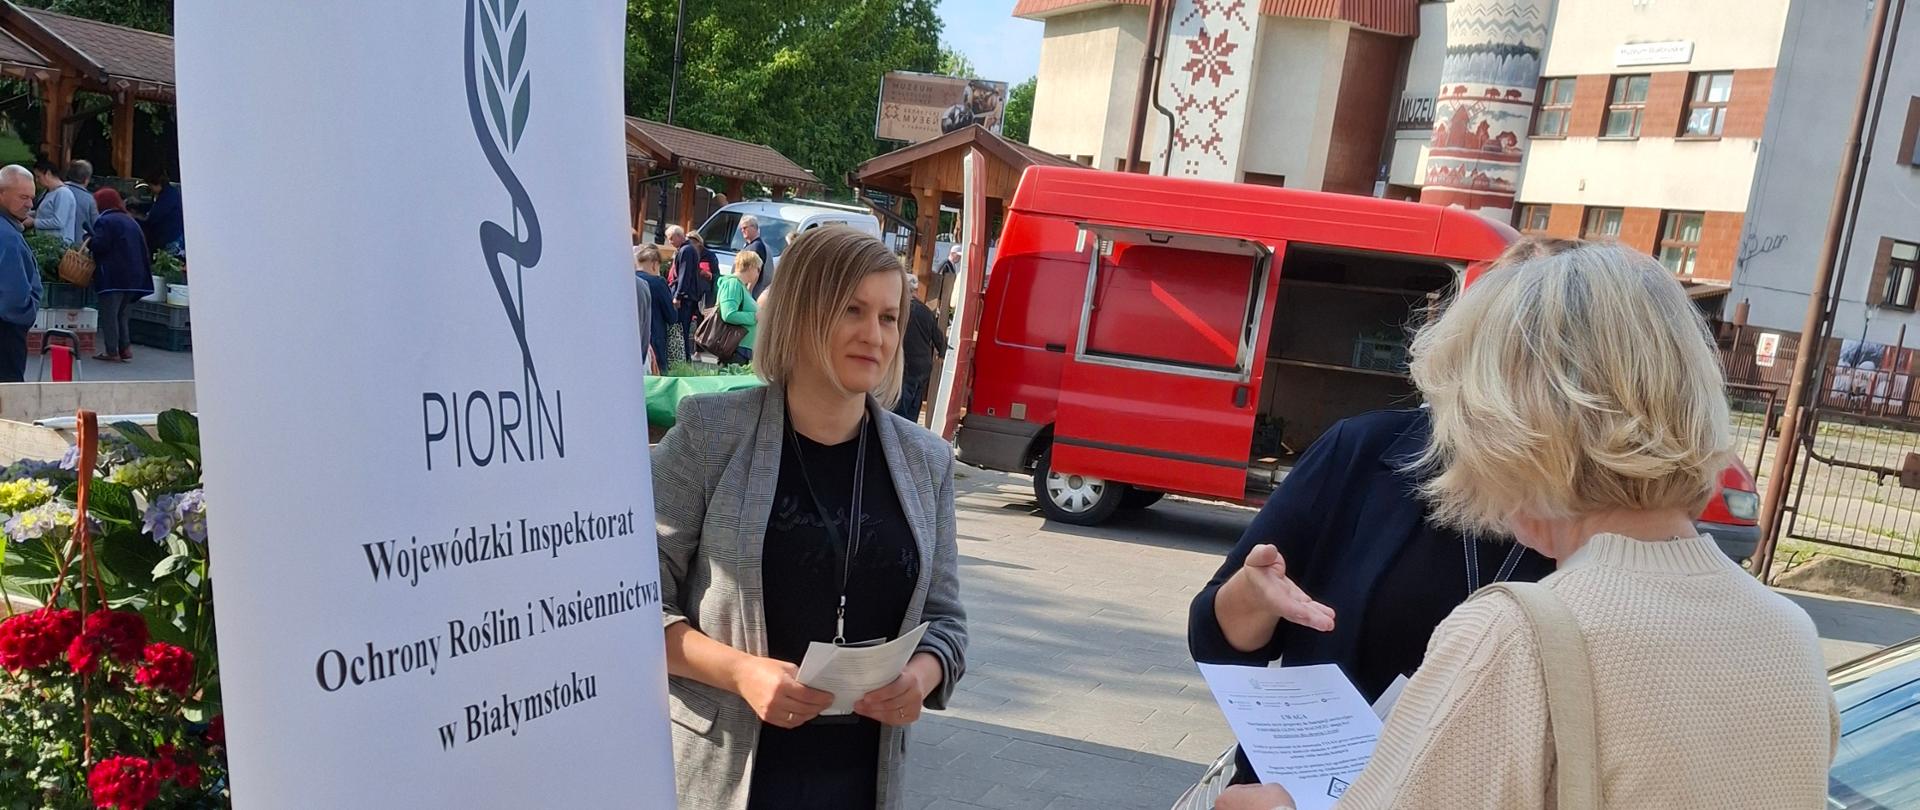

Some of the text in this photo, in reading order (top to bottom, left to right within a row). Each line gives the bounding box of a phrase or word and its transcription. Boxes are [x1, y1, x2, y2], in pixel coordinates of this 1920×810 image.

[1400, 97, 1437, 121] MUZEU
[422, 389, 566, 471] PIORIN
[362, 506, 635, 587] Wojewódzki Inspektorat
[315, 579, 659, 693] Ochrony Roślin i Nasiennictwa
[438, 671, 597, 753] w Białymstoku
